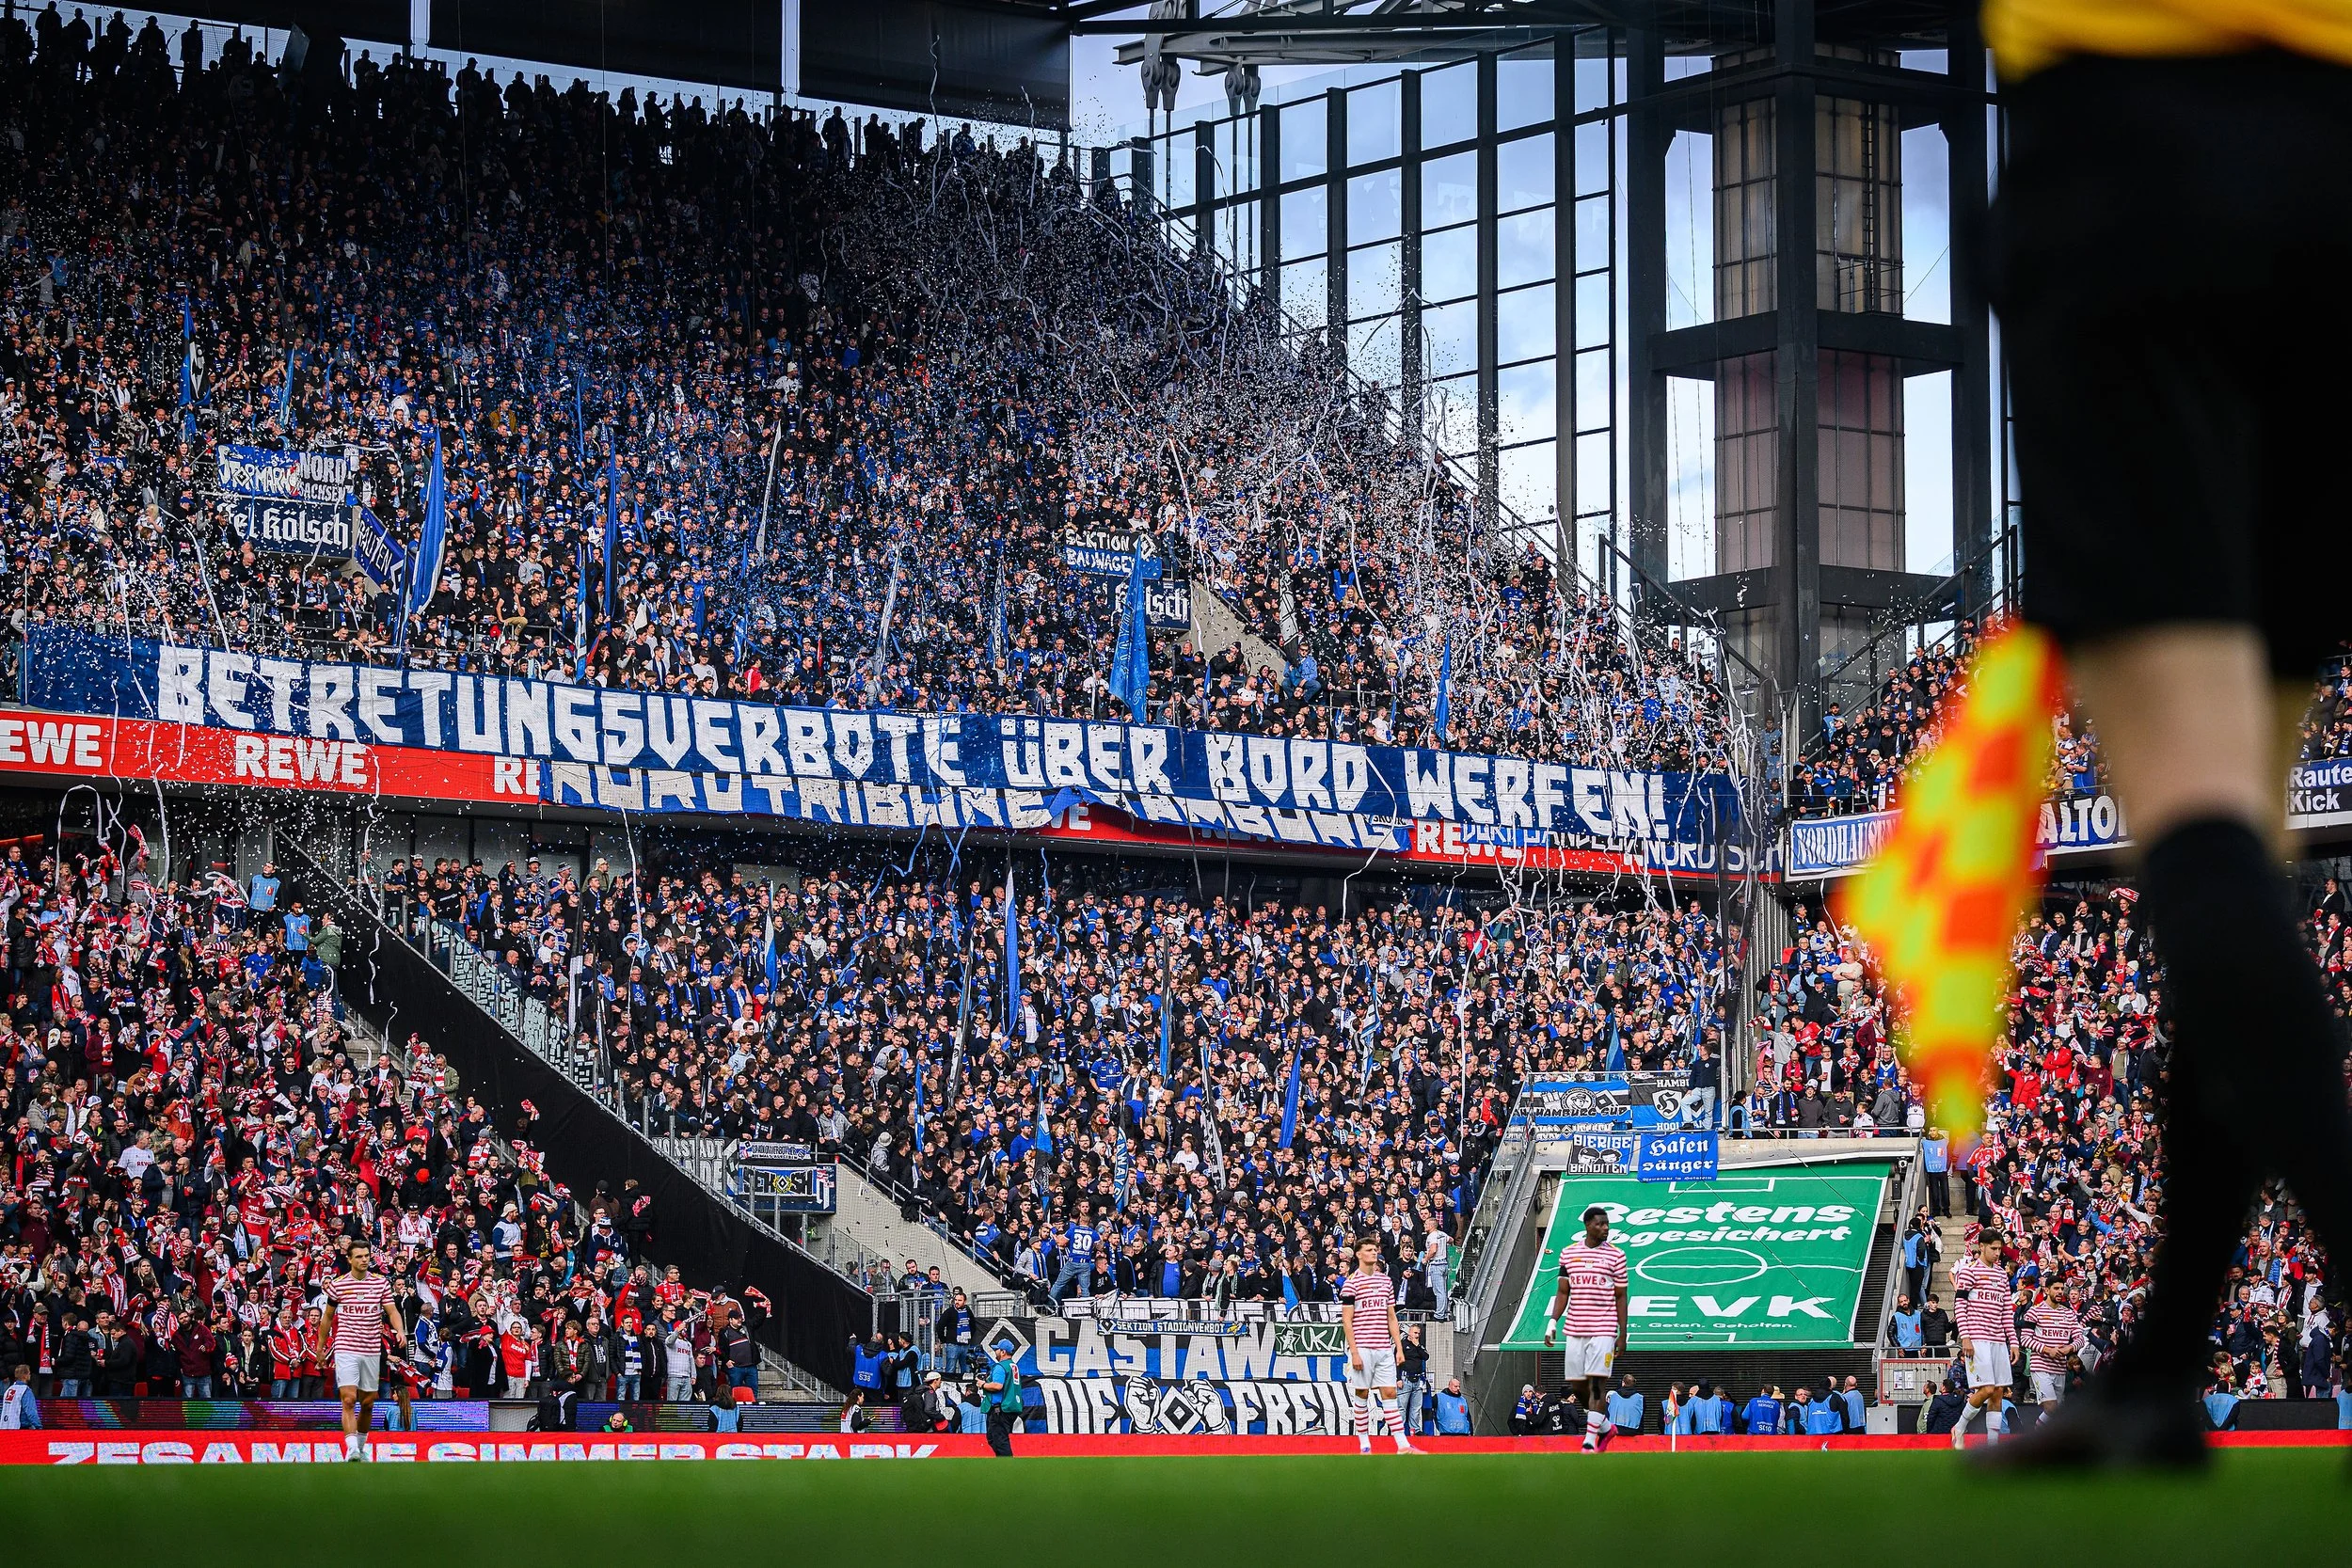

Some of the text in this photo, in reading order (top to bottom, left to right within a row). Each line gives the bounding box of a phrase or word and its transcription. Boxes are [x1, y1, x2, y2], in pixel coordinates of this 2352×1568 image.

[0, 721, 103, 768] EWE
[157, 644, 1670, 840] BETRETUNGSVERBOTE ÜBER BORD WERFEN!
[235, 735, 369, 785] REWE
[494, 756, 540, 796] RE
[2289, 788, 2341, 813] Kick
[1573, 1134, 1632, 1148] BIERIGE
[1649, 1136, 1709, 1157] Hafen
[1073, 1233, 1093, 1252] 30
[1570, 1275, 1598, 1286] REWE
[1361, 1300, 1385, 1308] REWE
[1978, 1291, 2000, 1301] REWE
[342, 1305, 368, 1314] REWE
[1116, 1321, 1226, 1334] SEKTION STADIONVERBOT
[2042, 1328, 2064, 1338] REWE
[1038, 1317, 1350, 1382] CASTAW
